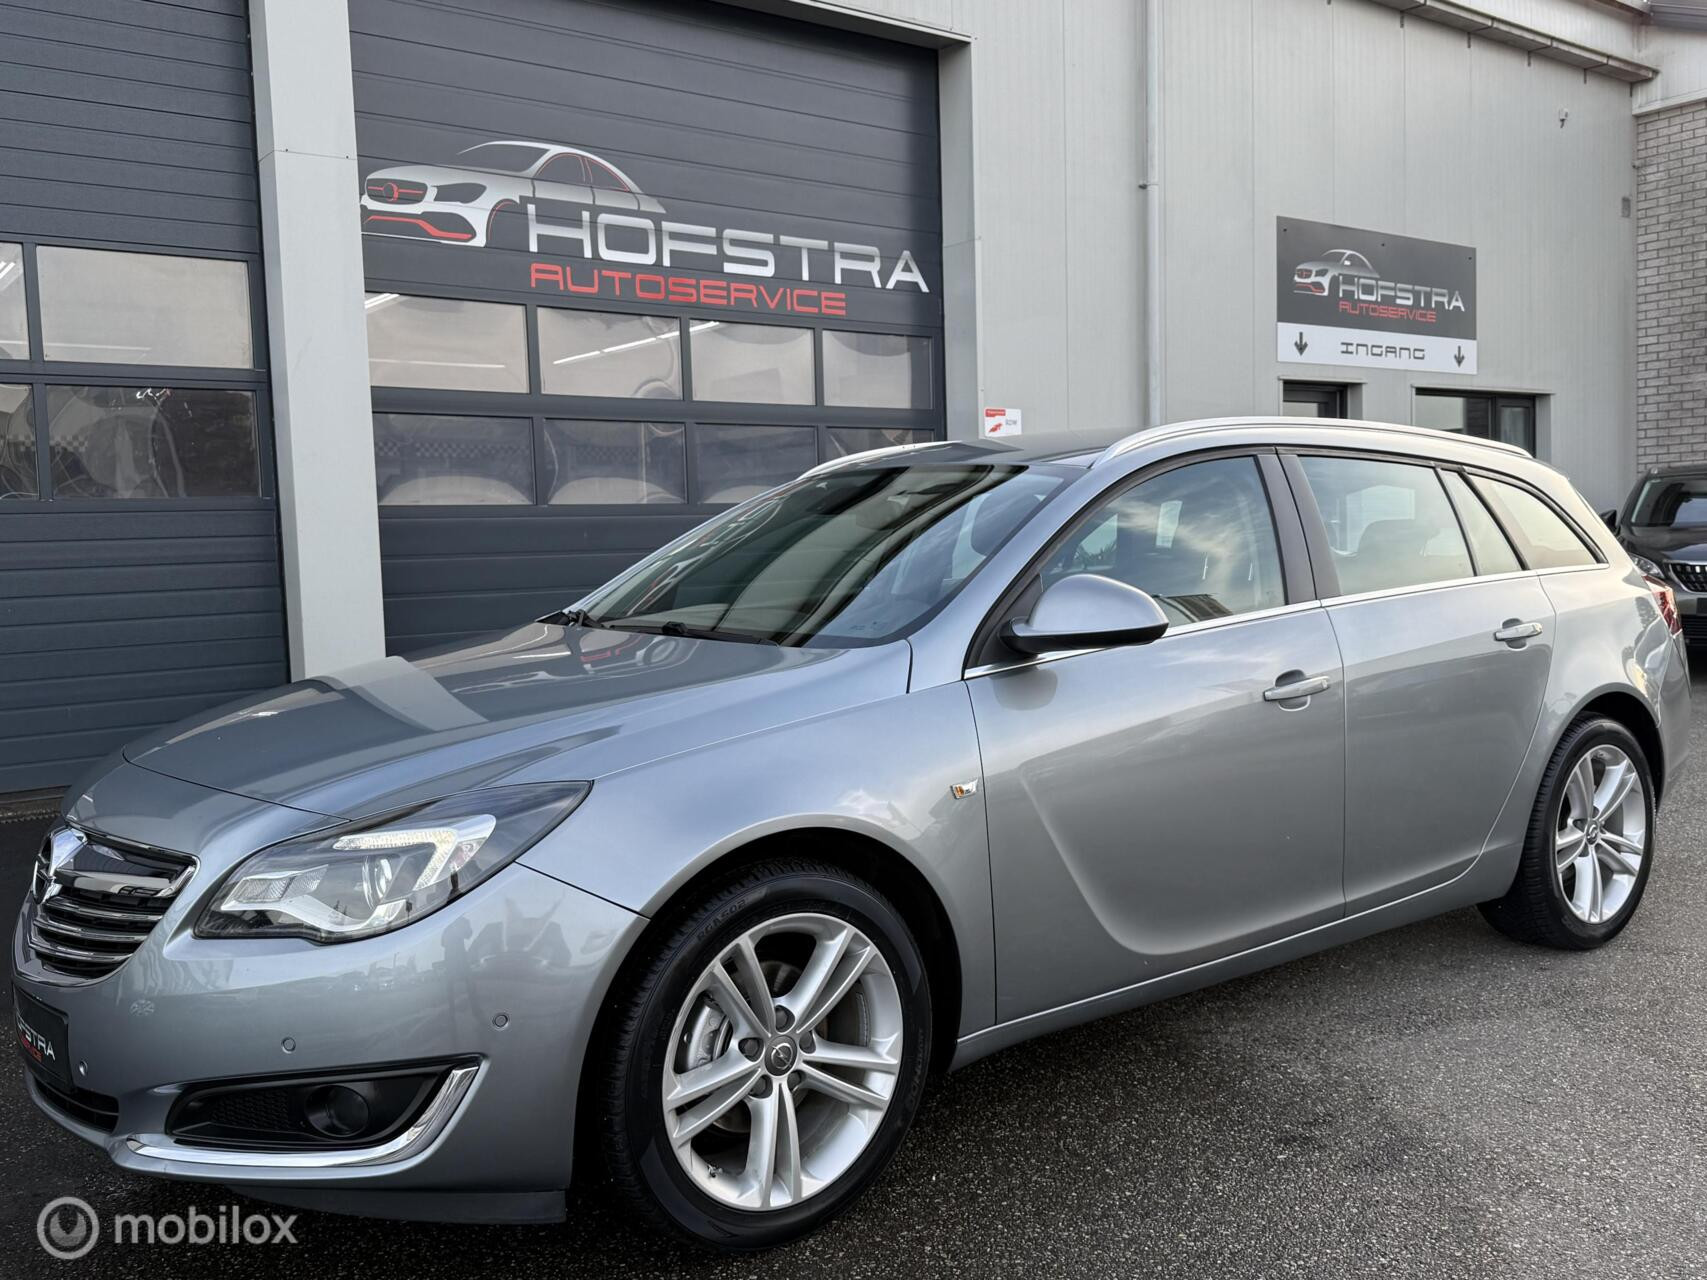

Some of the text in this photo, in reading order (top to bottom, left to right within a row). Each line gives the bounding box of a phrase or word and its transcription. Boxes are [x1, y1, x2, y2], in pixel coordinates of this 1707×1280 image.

[527, 203, 930, 293] HOFSTRA
[530, 262, 847, 316] AUTOSERVICE
[1339, 275, 1465, 312] HOFSTRA
[1339, 300, 1437, 322] AUTOSERVICE
[1340, 342, 1425, 360] INGANG
